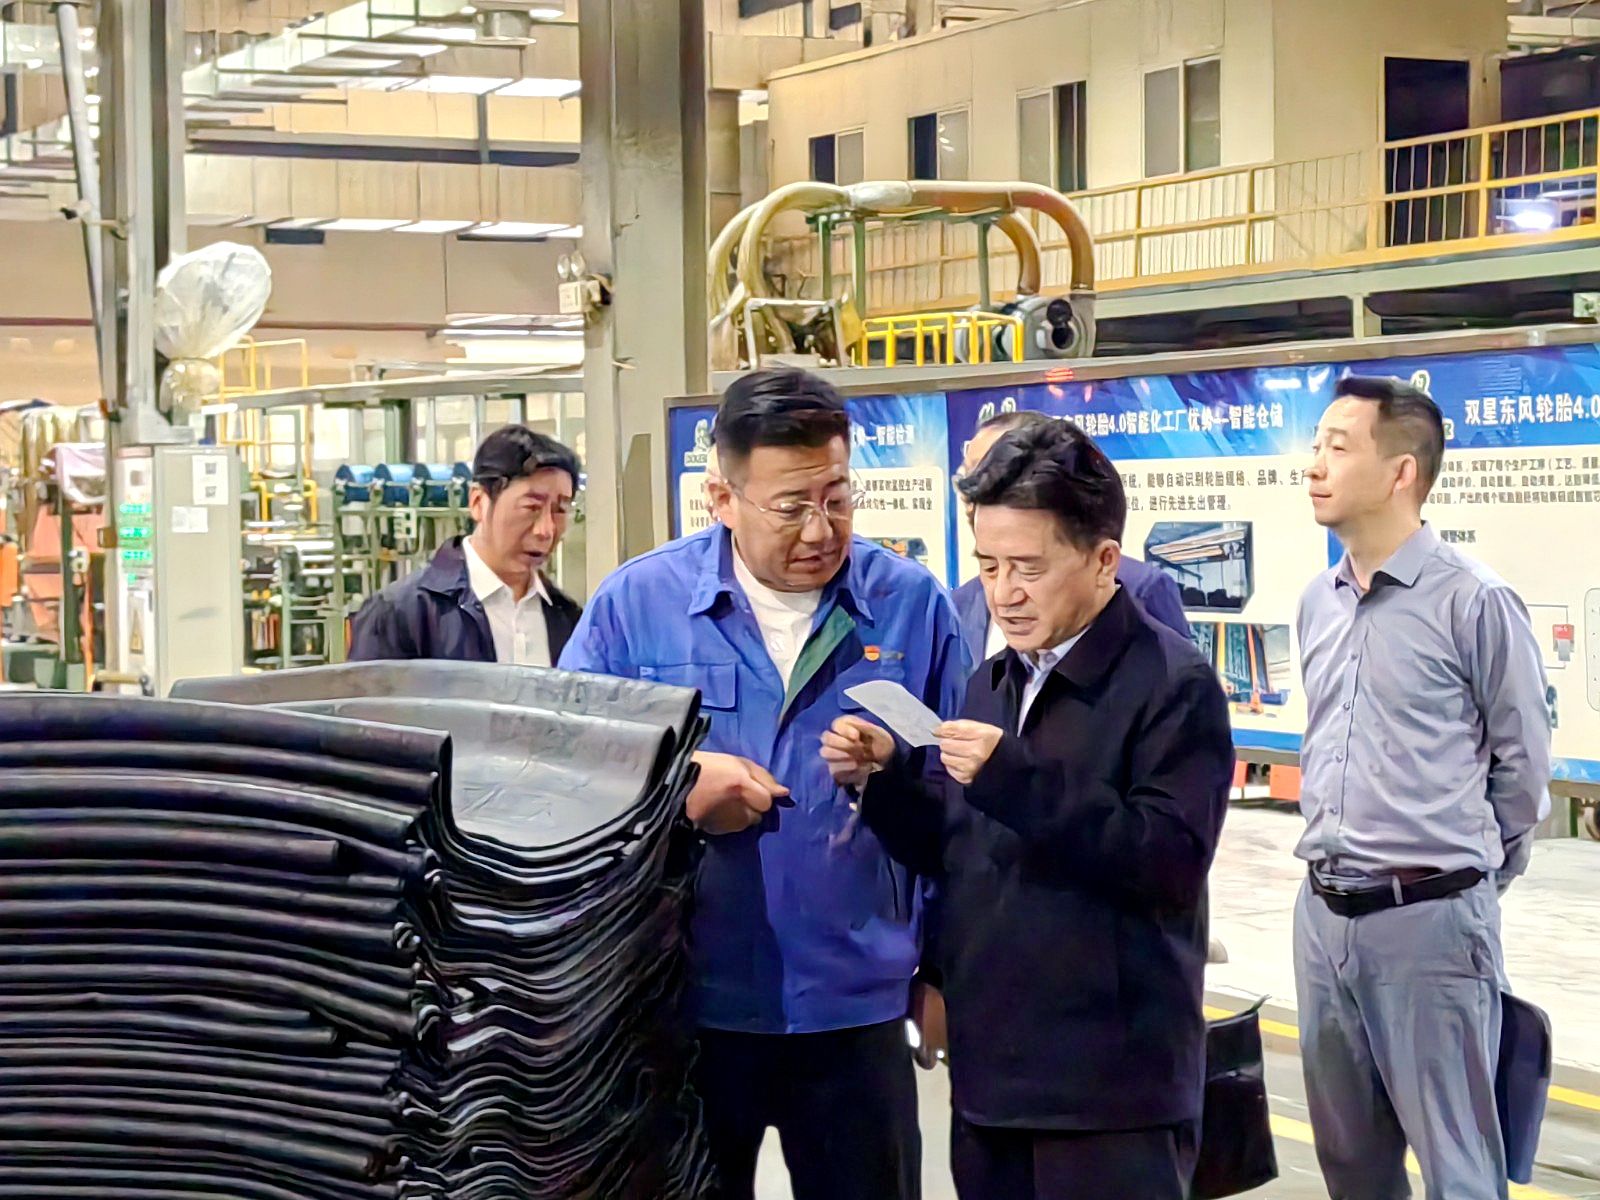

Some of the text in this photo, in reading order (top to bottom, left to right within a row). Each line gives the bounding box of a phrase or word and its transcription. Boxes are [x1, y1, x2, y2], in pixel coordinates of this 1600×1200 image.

[1052, 403, 1284, 437] 风轮胎4.0智能化工厂优势—智能仓储
[1126, 494, 1231, 511] 位，进行先进先出管理。
